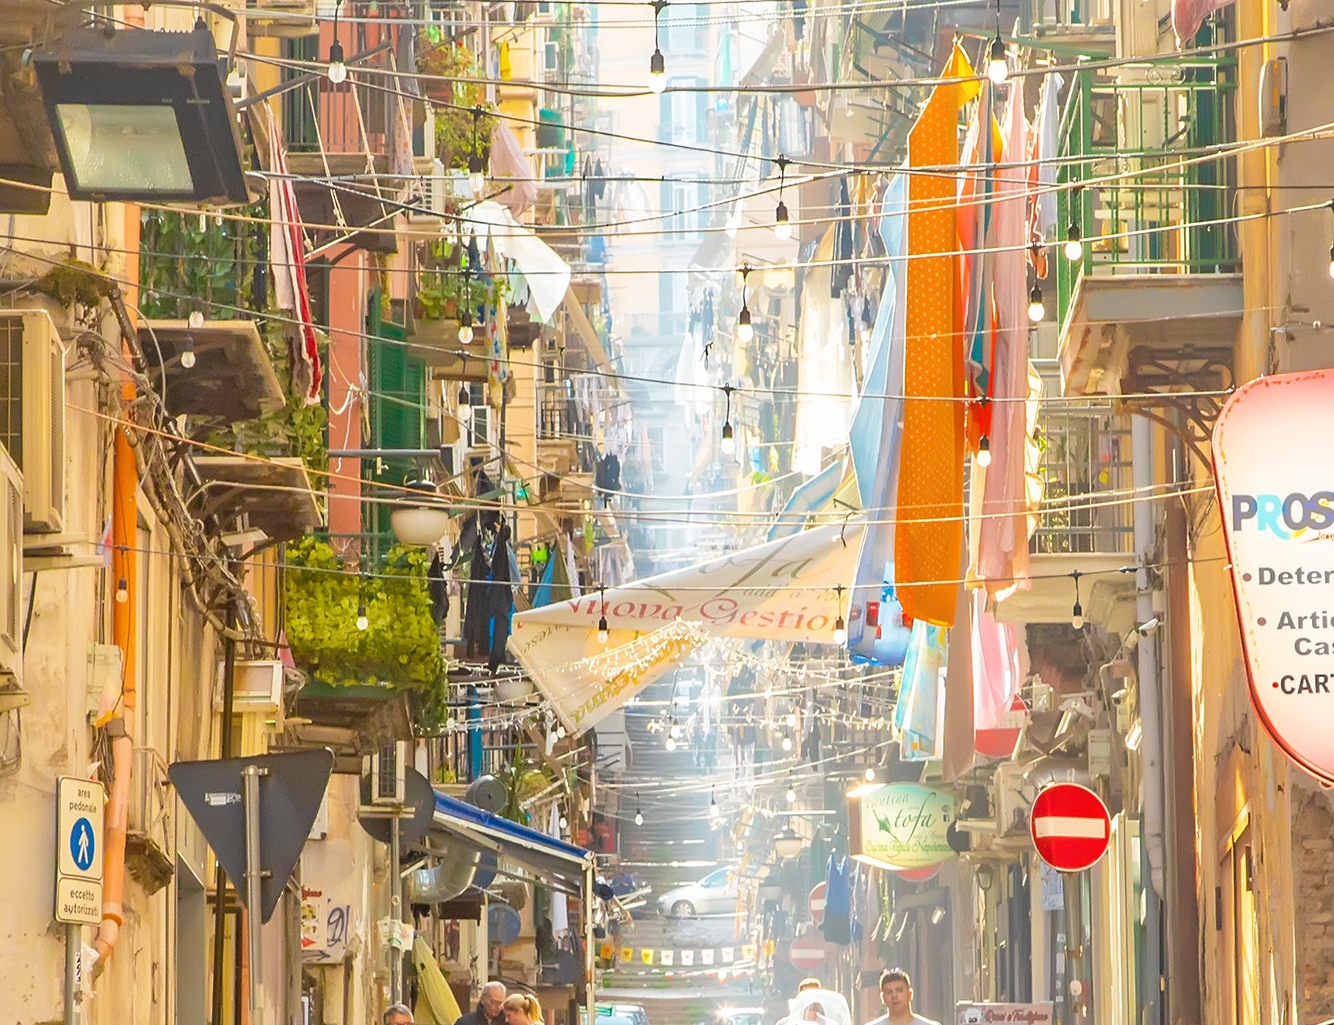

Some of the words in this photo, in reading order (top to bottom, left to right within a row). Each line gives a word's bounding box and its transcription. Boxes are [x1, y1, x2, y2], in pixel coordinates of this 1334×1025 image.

[78, 788, 91, 799] area
[69, 801, 97, 814] pedonale
[70, 888, 95, 901] eccetto
[63, 903, 99, 917] autorizzati
